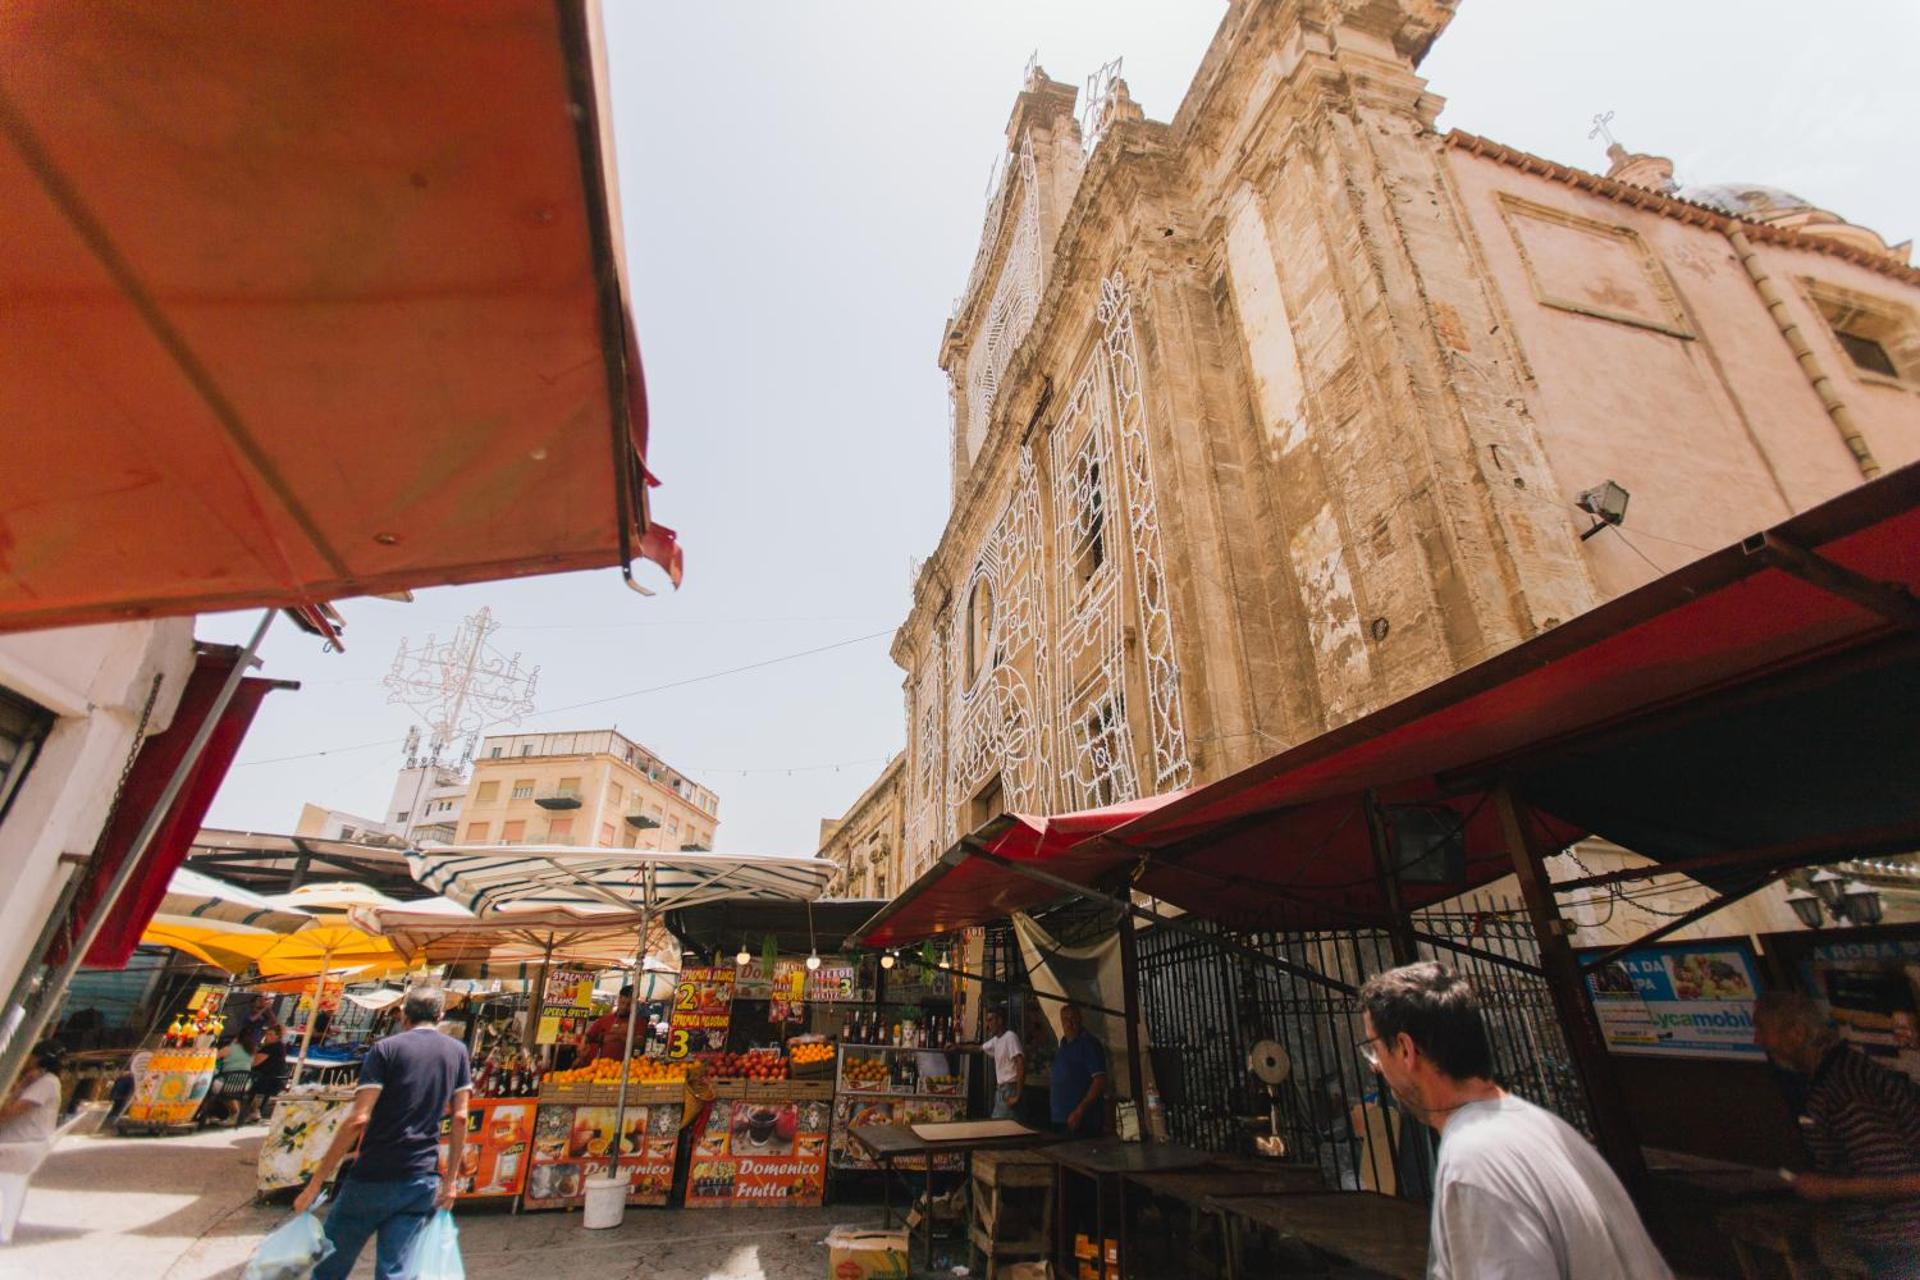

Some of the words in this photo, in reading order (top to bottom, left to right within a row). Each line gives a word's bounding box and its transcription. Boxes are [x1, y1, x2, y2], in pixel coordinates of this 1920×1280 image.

[676, 983, 695, 1011] 2
[841, 978, 852, 997] 3
[1651, 1006, 1755, 1028] ycamobil
[670, 1029, 689, 1058] 3
[739, 1159, 820, 1176] Domenico
[736, 1182, 787, 1199] Frutta
